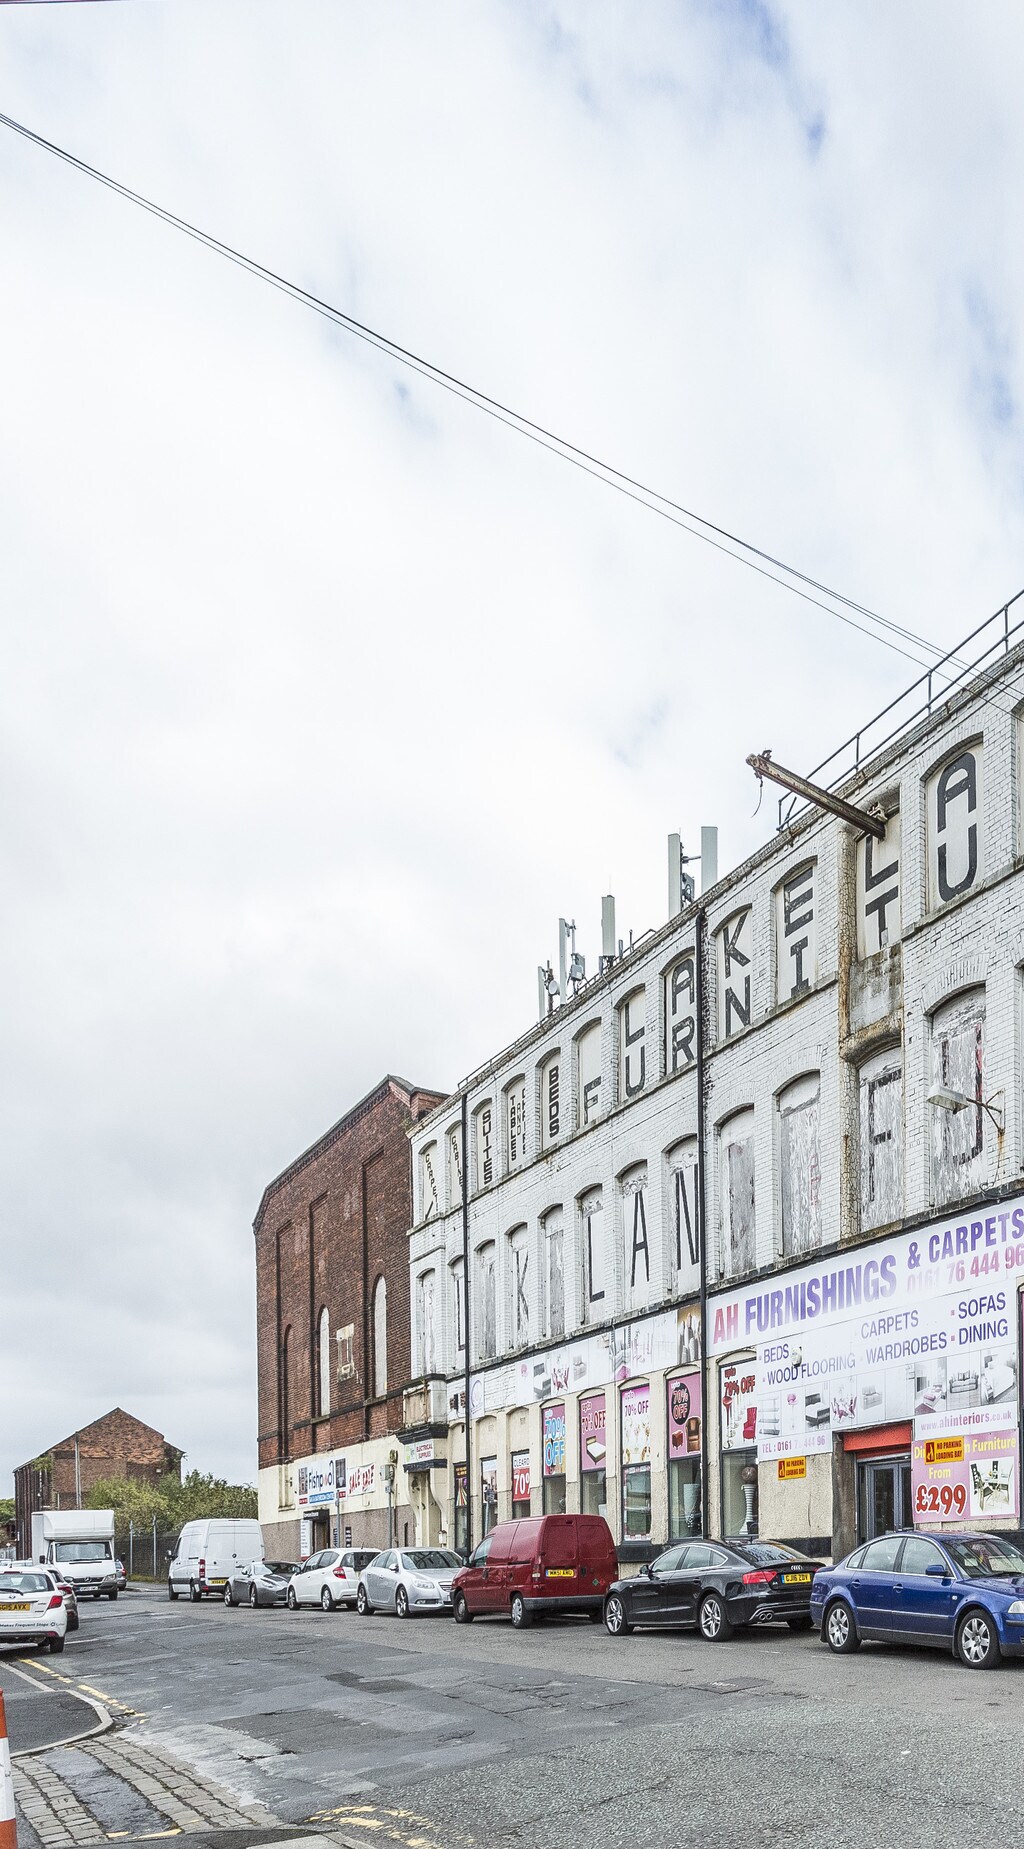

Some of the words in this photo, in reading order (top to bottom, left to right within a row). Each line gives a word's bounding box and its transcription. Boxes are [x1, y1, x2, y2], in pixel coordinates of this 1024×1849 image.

[549, 1065, 560, 1138] BEDS
[482, 1109, 492, 1185] SUITES
[713, 1303, 739, 1344] AH
[745, 1254, 897, 1335] FURNISHINGS
[907, 1242, 921, 1269] &
[929, 1208, 1024, 1263] CARPETS
[947, 1259, 966, 1285] 76
[970, 1250, 1000, 1277] 444
[861, 1310, 919, 1339] CARPETS
[958, 1292, 1006, 1319] SOFAS
[763, 1343, 789, 1364] BEDS
[767, 1366, 799, 1386] WOOD
[801, 1353, 856, 1379] FLOORING
[866, 1331, 947, 1365] WARDROBES
[958, 1318, 1008, 1345] DINING
[740, 1375, 756, 1394] OFF
[673, 1388, 689, 1404] 70%
[624, 1403, 637, 1417] 70%
[637, 1400, 649, 1414] OFF
[673, 1404, 688, 1420] OFF
[544, 1416, 566, 1440] 70%
[582, 1413, 593, 1434] 70%
[594, 1410, 605, 1429] OFF
[920, 1410, 1012, 1431] www.ahinteriors.co.uk
[545, 1440, 565, 1466] OFF
[762, 1443, 772, 1453] TEL
[777, 1440, 792, 1452] 0161
[935, 1451, 954, 1460] LOADING
[954, 1450, 963, 1458] BAY
[943, 1440, 962, 1449] PARKING
[972, 1437, 1016, 1452] Furniture
[928, 1467, 951, 1479] From
[916, 1484, 967, 1515] £299
